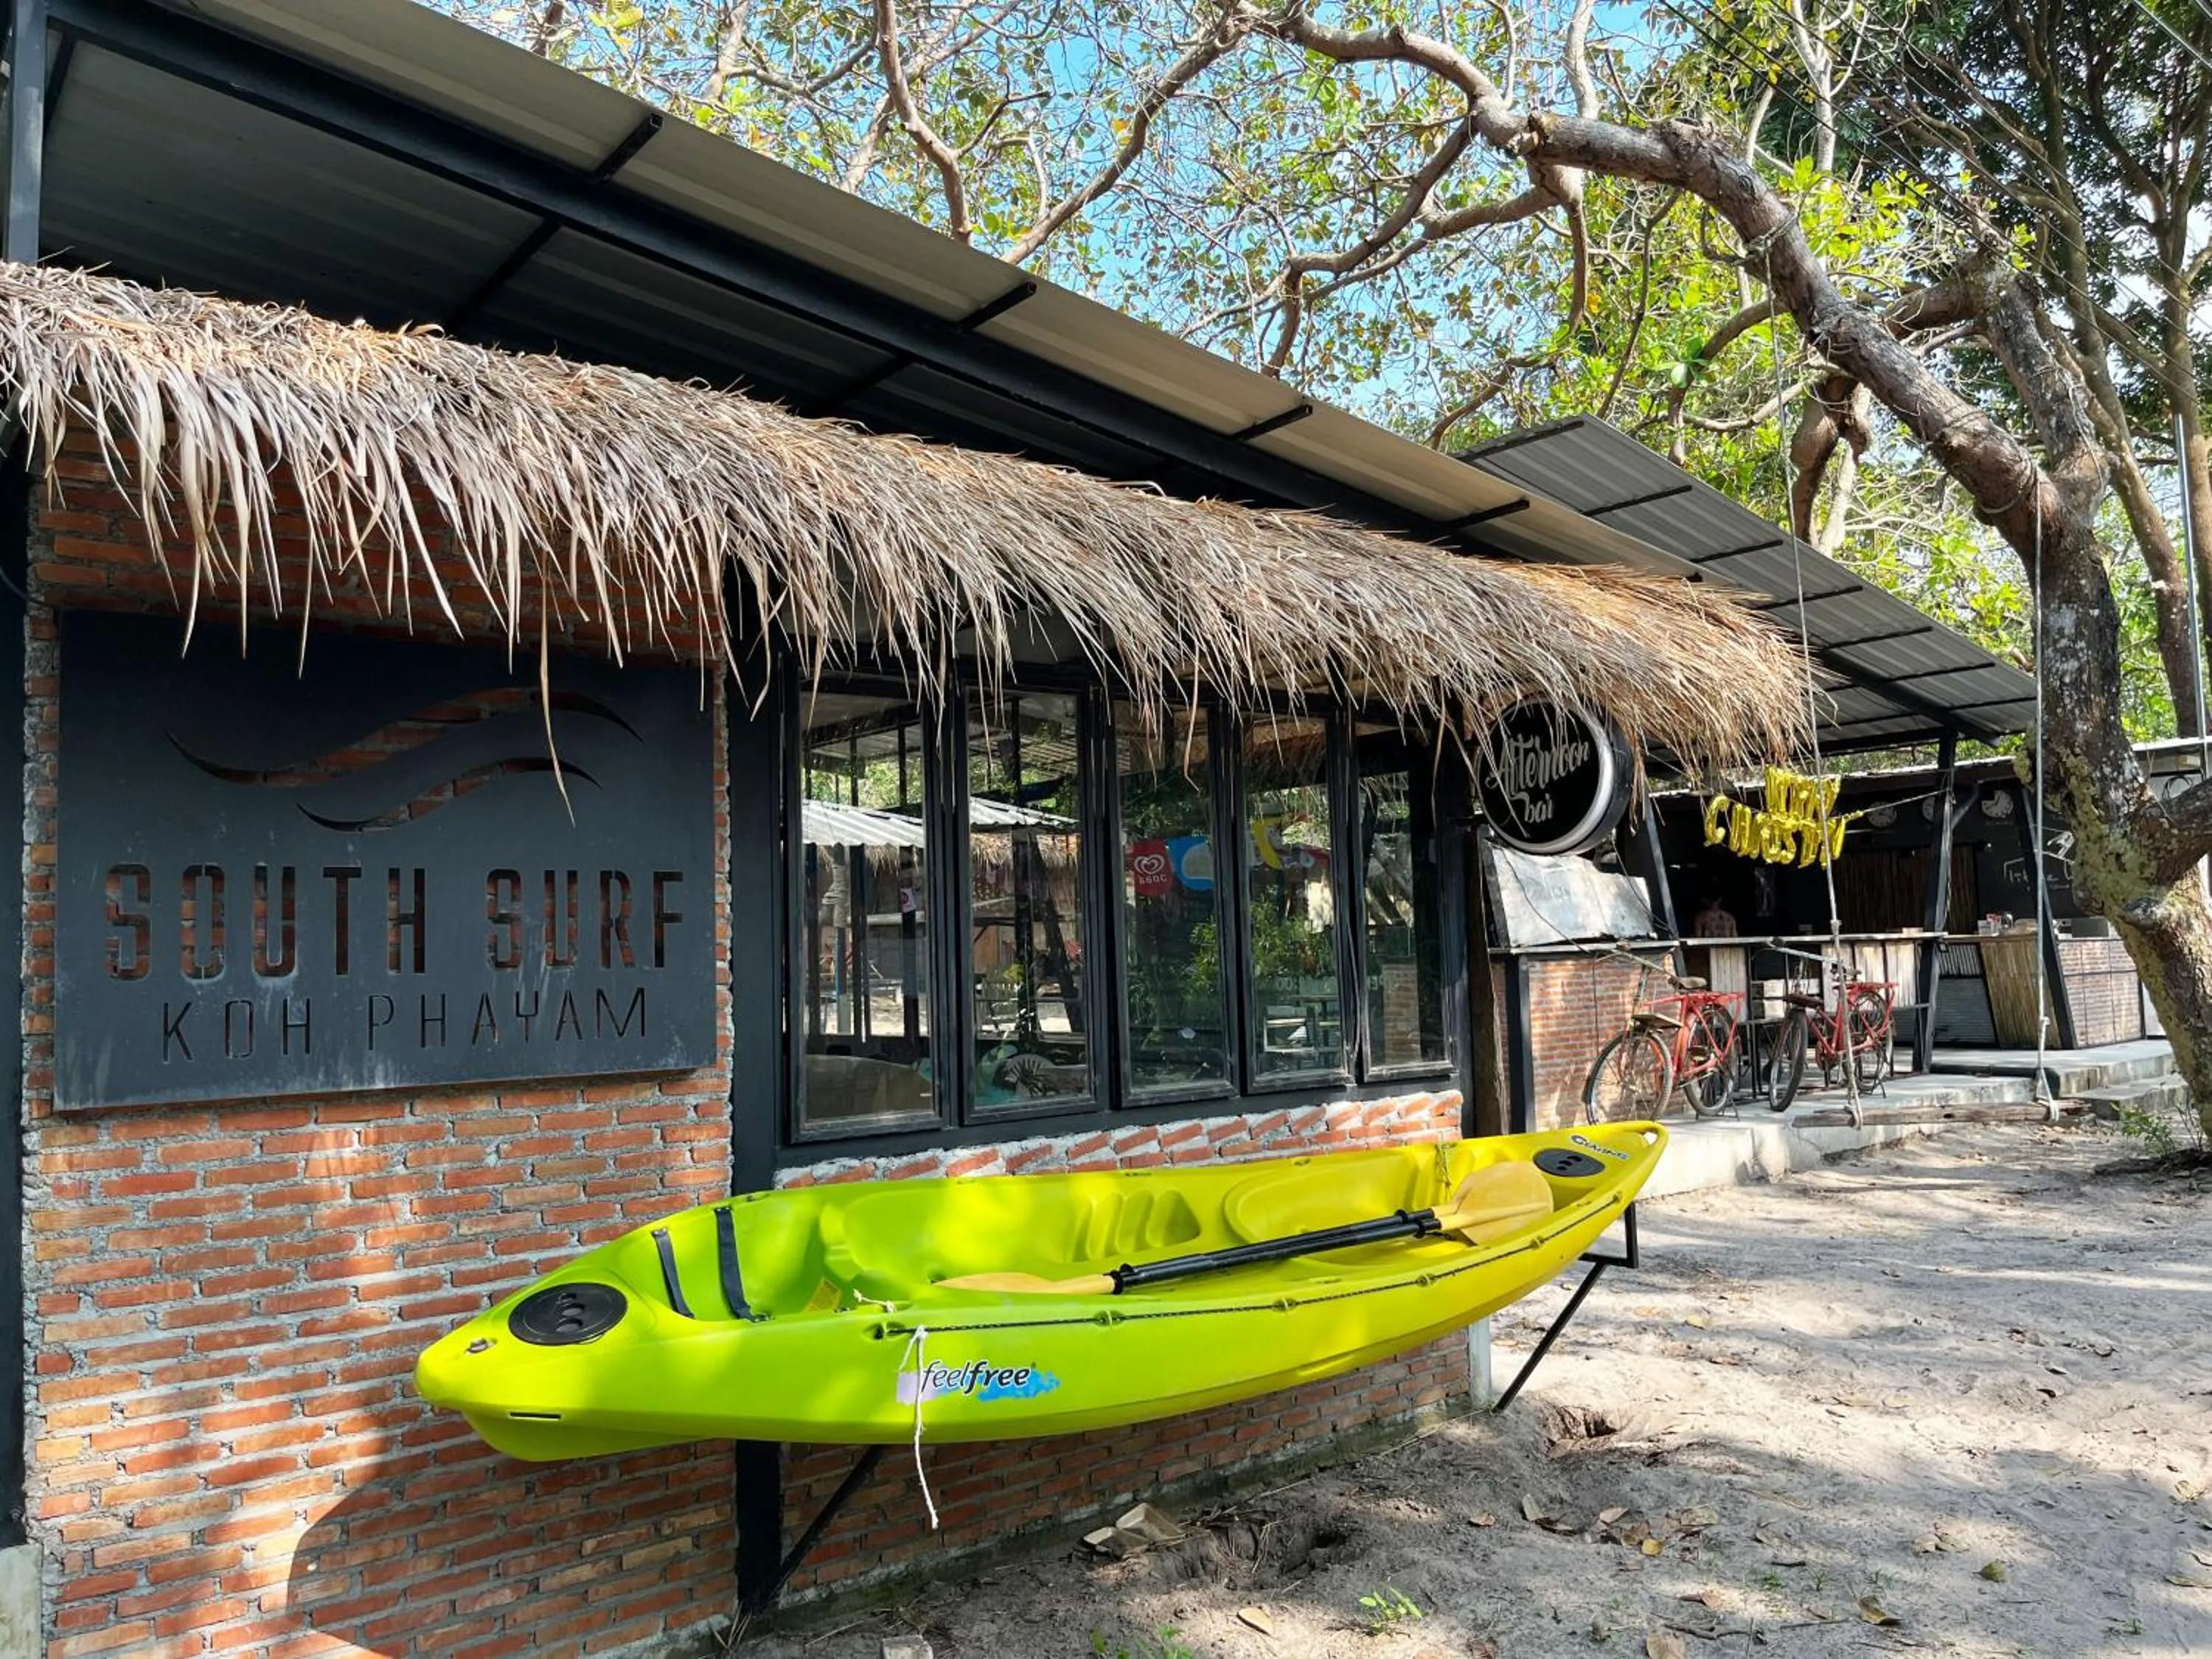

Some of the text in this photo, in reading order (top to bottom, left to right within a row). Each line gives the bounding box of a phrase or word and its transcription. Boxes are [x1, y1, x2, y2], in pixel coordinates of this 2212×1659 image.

[105, 863, 684, 980] SOUTH SURF
[162, 987, 647, 1063] KOH PHAYAM
[921, 1360, 1030, 1394] feelfree
